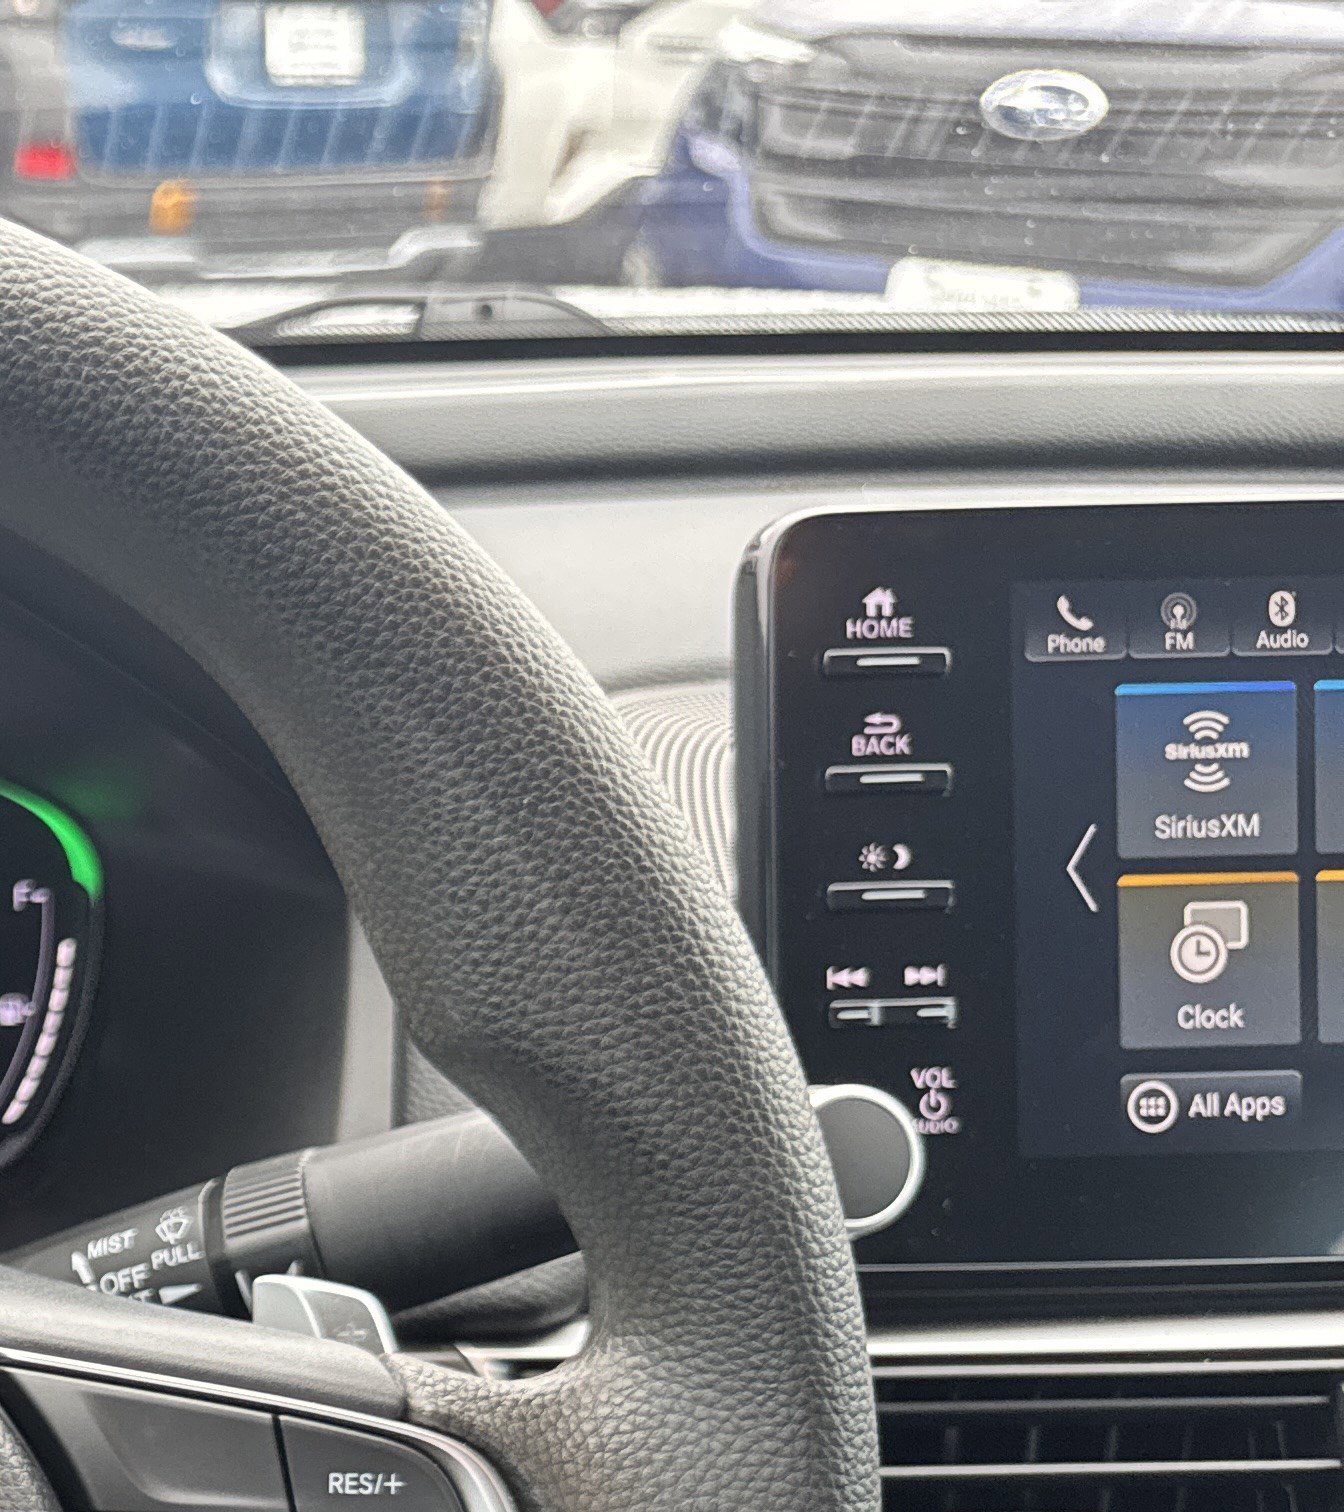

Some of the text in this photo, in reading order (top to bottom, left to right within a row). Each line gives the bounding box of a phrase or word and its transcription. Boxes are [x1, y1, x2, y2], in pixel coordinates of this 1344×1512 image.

[845, 617, 914, 639] HOME
[1256, 629, 1309, 649] Audio
[1047, 633, 1106, 653] Phone
[1165, 631, 1194, 650] FM
[851, 734, 912, 756] BACK
[1154, 813, 1261, 839] SiriusXM
[1177, 1003, 1245, 1030] Clock
[910, 1066, 957, 1089] VOL
[1188, 1092, 1286, 1122] All Apps
[913, 1116, 961, 1134] UDIO
[87, 1228, 137, 1260] MIST
[151, 1241, 206, 1270] PULL
[99, 1263, 152, 1295] OFF
[328, 1472, 406, 1494] RES/+
